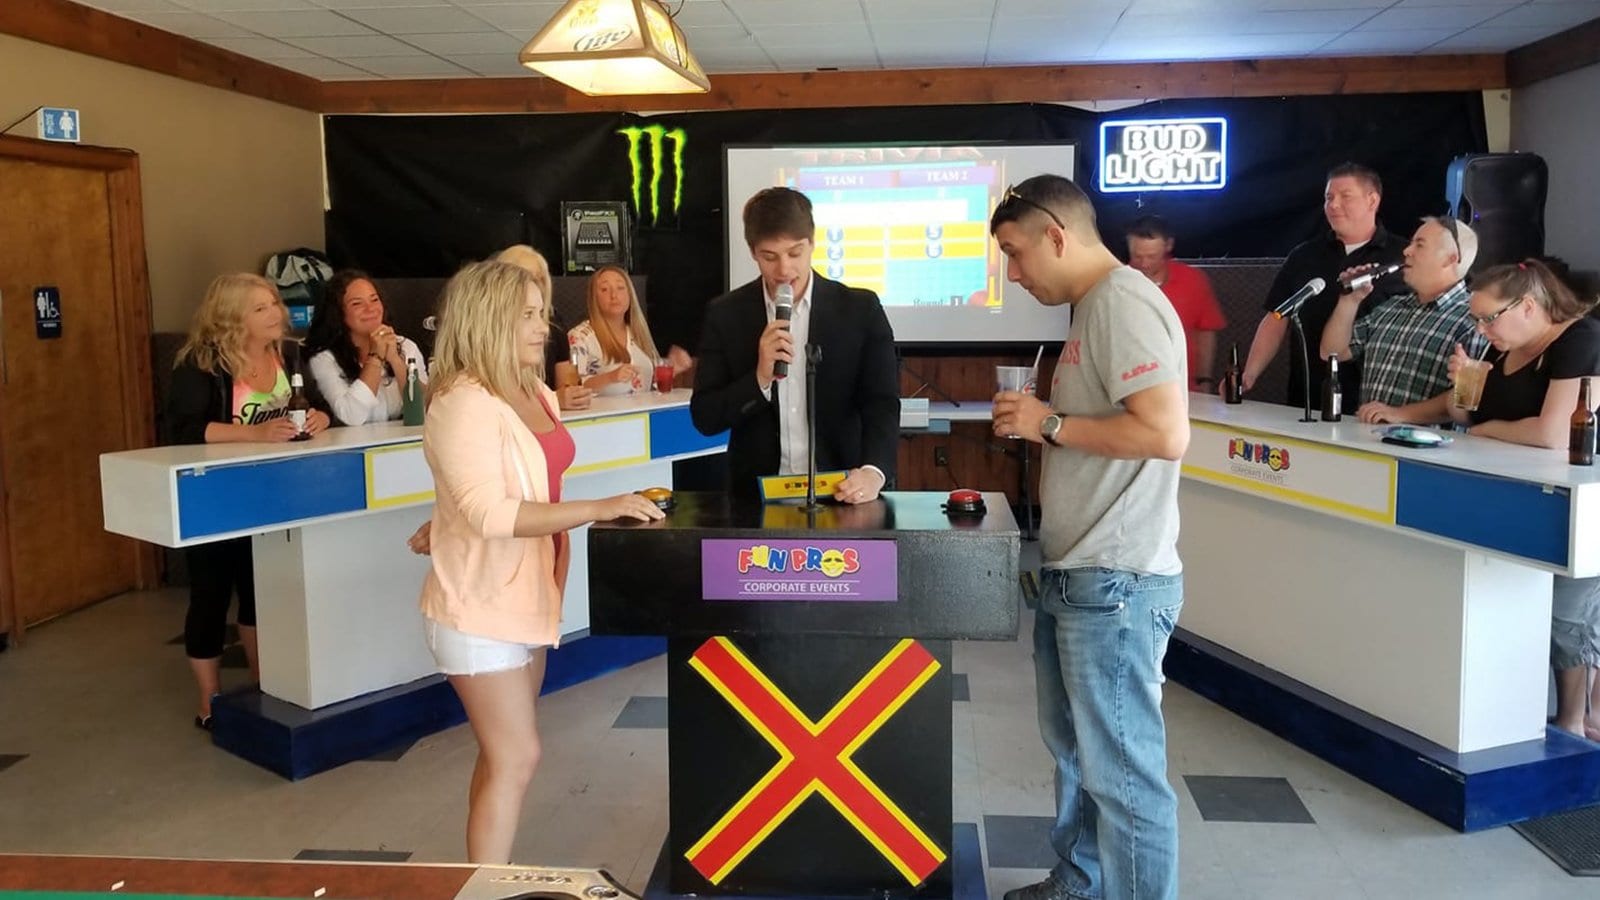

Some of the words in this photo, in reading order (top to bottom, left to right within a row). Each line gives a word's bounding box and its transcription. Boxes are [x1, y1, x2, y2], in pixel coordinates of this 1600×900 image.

[1123, 124, 1207, 155] BUD
[927, 170, 955, 182] TEAM
[1106, 151, 1221, 184] LIGHT
[824, 174, 853, 186] TEAM
[738, 546, 787, 572] FUN
[791, 547, 860, 577] PROS
[744, 582, 806, 592] CORPORATE
[810, 583, 850, 593] EVENTS
